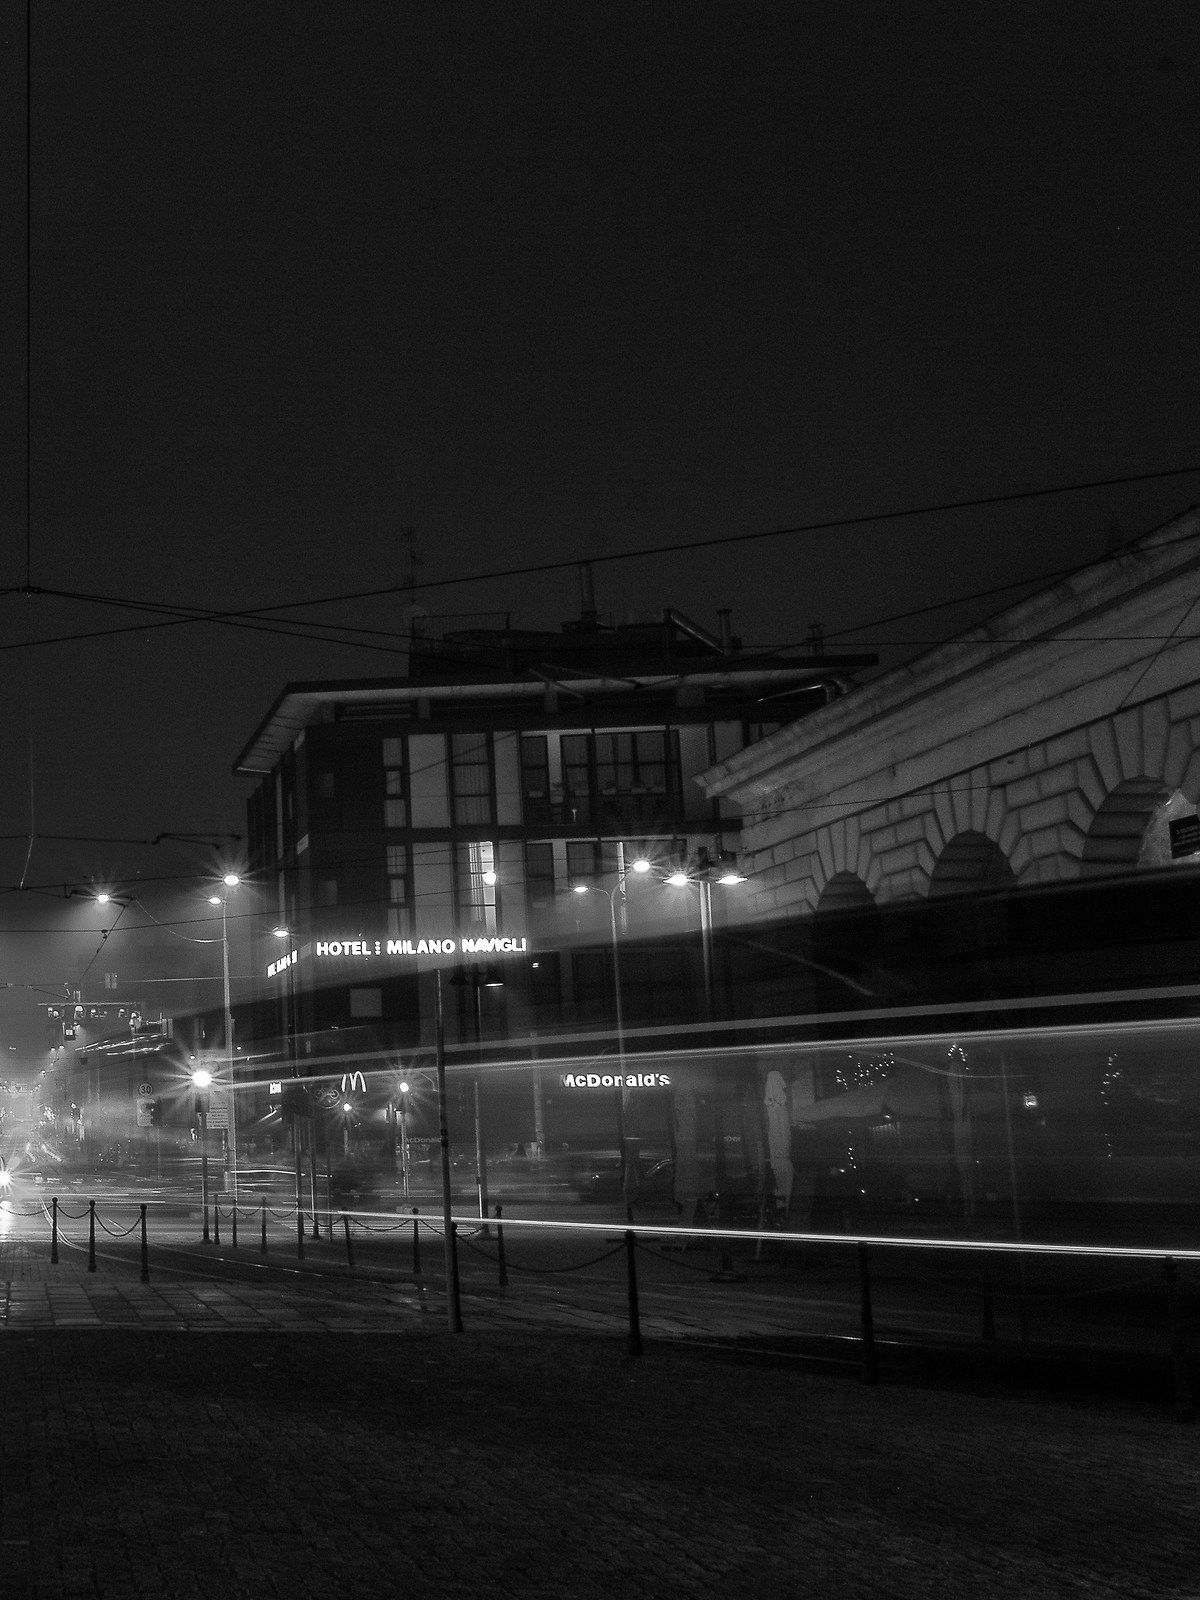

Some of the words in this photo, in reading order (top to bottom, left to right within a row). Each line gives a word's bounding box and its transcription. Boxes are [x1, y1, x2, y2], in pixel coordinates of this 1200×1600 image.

[316, 941, 372, 956] HOTEL
[387, 939, 456, 955] MILANO
[461, 938, 527, 953] NAVIGLI
[563, 1073, 671, 1088] McDonald's
[141, 1086, 151, 1094] 30
